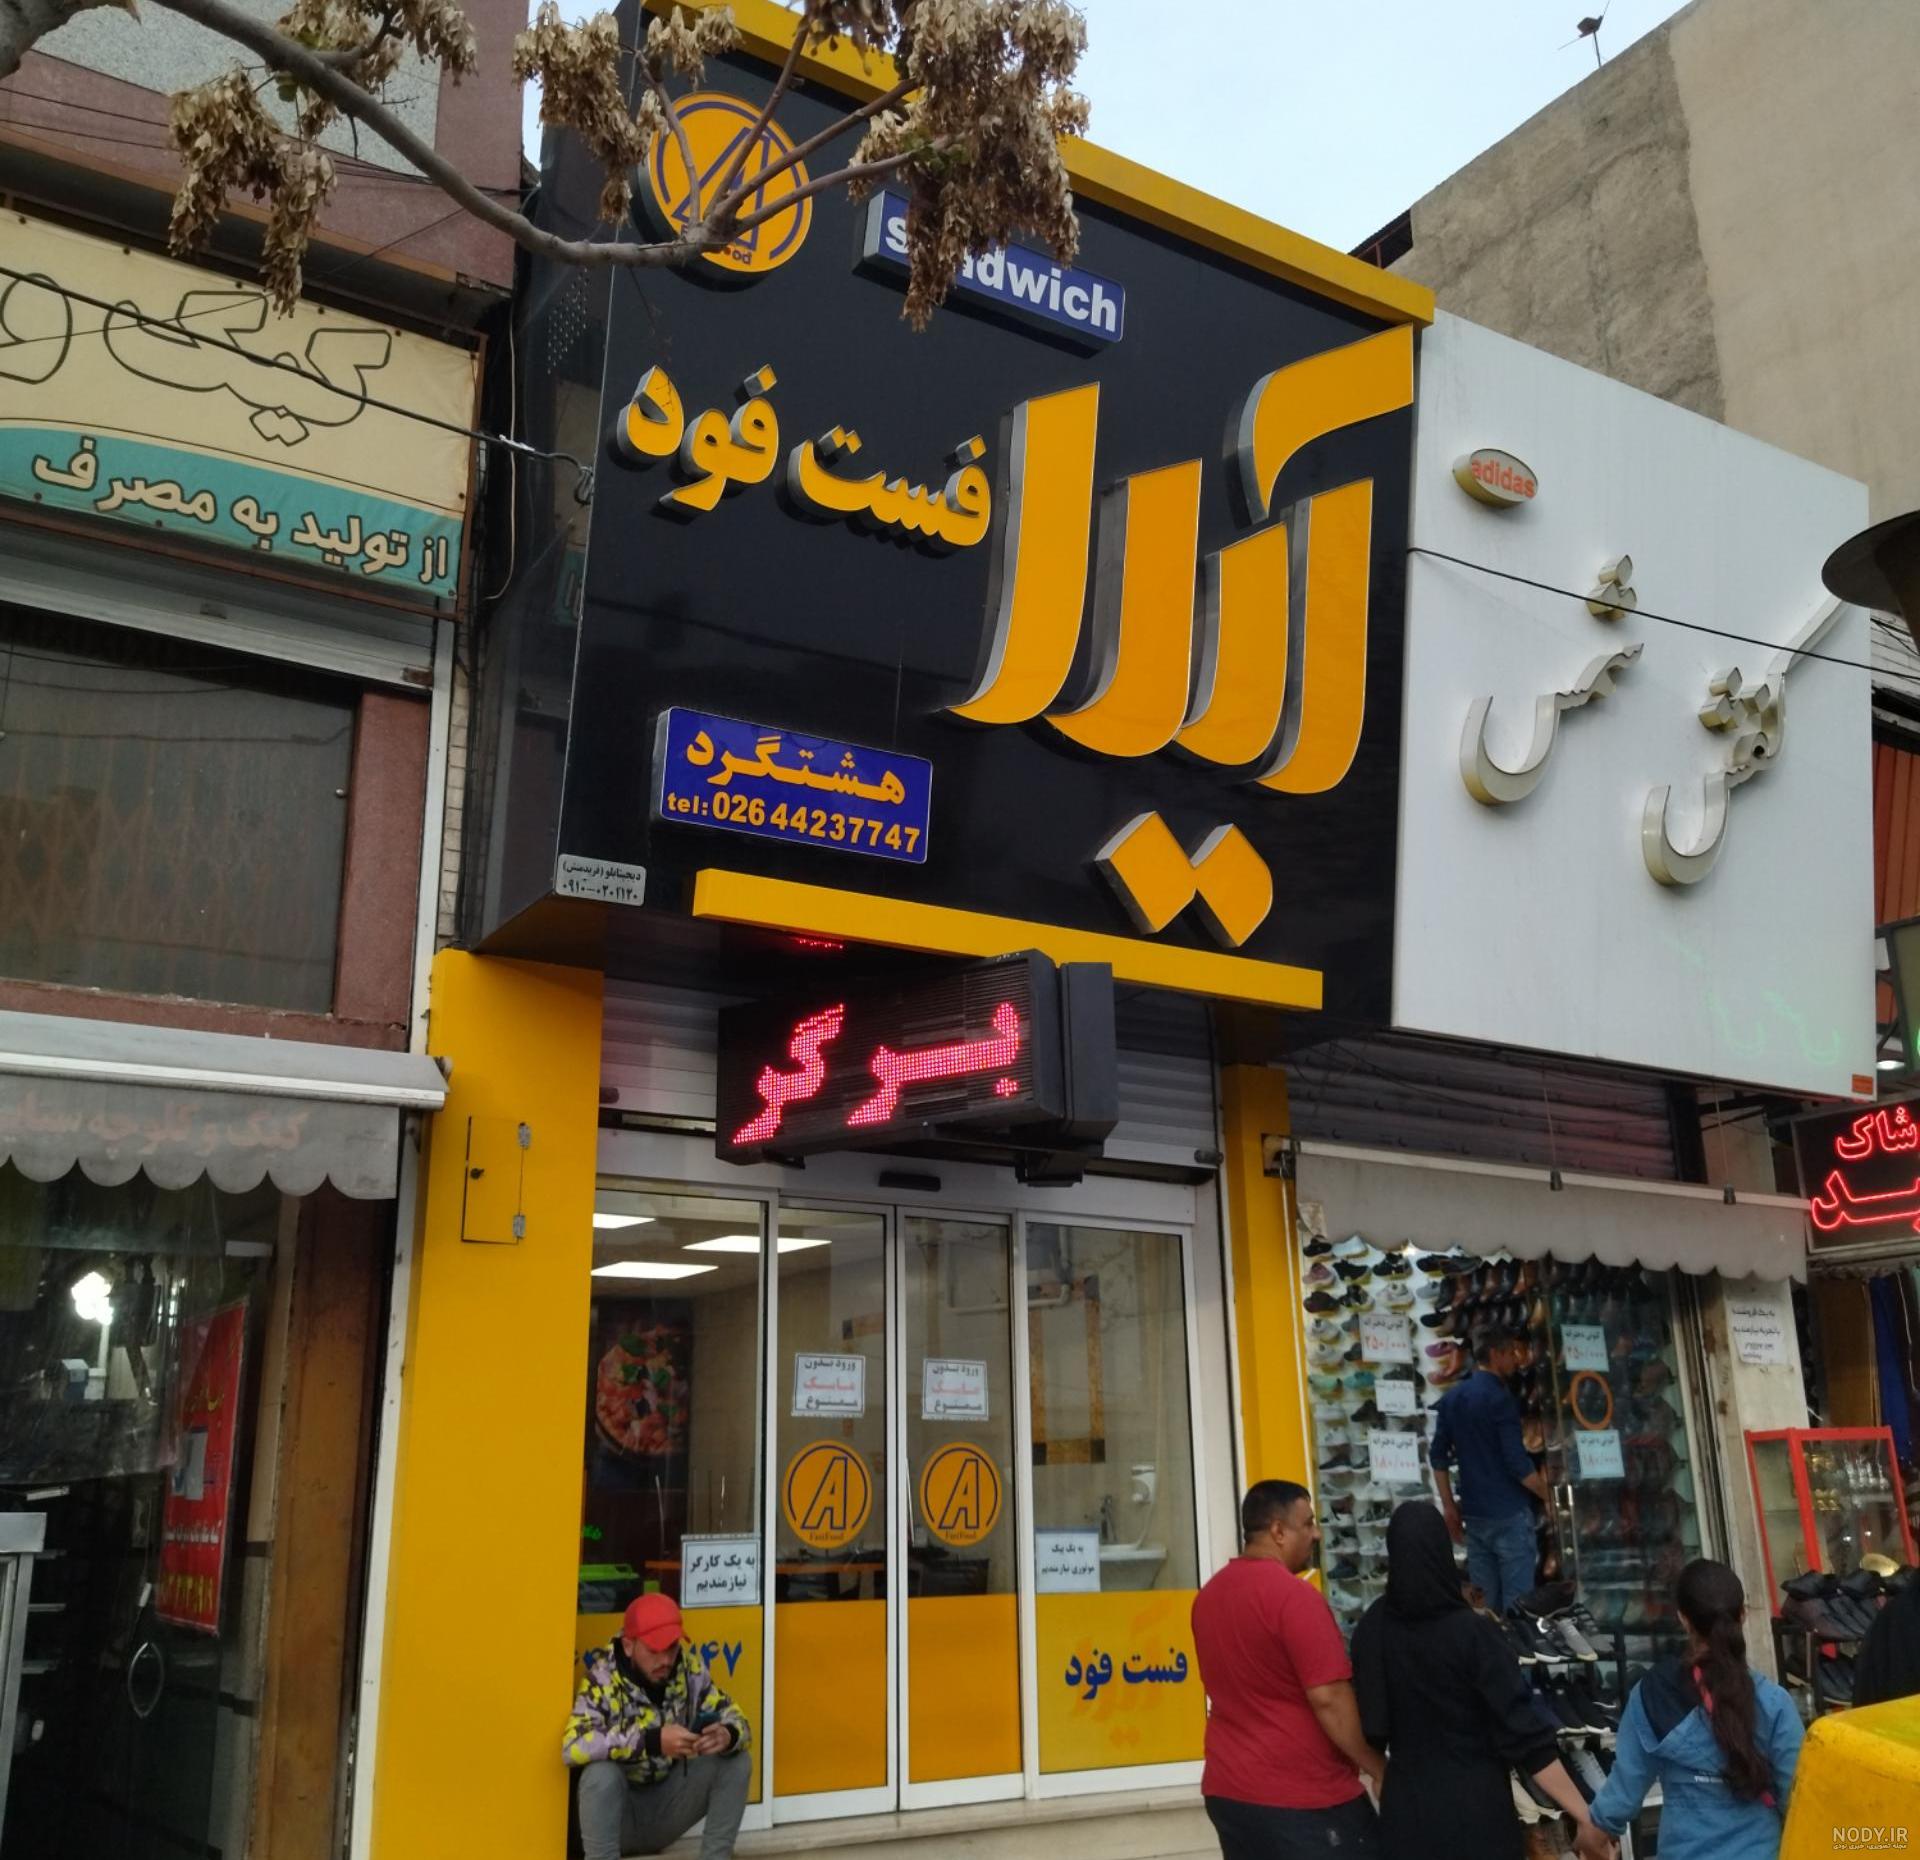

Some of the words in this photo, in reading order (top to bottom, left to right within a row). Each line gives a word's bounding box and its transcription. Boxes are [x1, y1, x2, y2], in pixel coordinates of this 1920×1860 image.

[886, 215, 1117, 333] sdwich
[616, 364, 780, 512] فود
[32, 435, 217, 525] مصرف
[789, 425, 992, 548] فست
[1471, 458, 1536, 499] adidas
[231, 495, 281, 552] به
[291, 511, 409, 575] تولید
[418, 535, 448, 585] از
[685, 730, 906, 806] هشتگرد
[666, 790, 709, 817] tel:
[712, 791, 766, 827] 026
[769, 805, 921, 854] 44237747
[800, 1456, 849, 1530] A
[938, 1458, 980, 1529] A
[724, 1554, 742, 1569] یک
[1064, 1648, 1113, 1701] فود
[1122, 1647, 1188, 1684] فست
